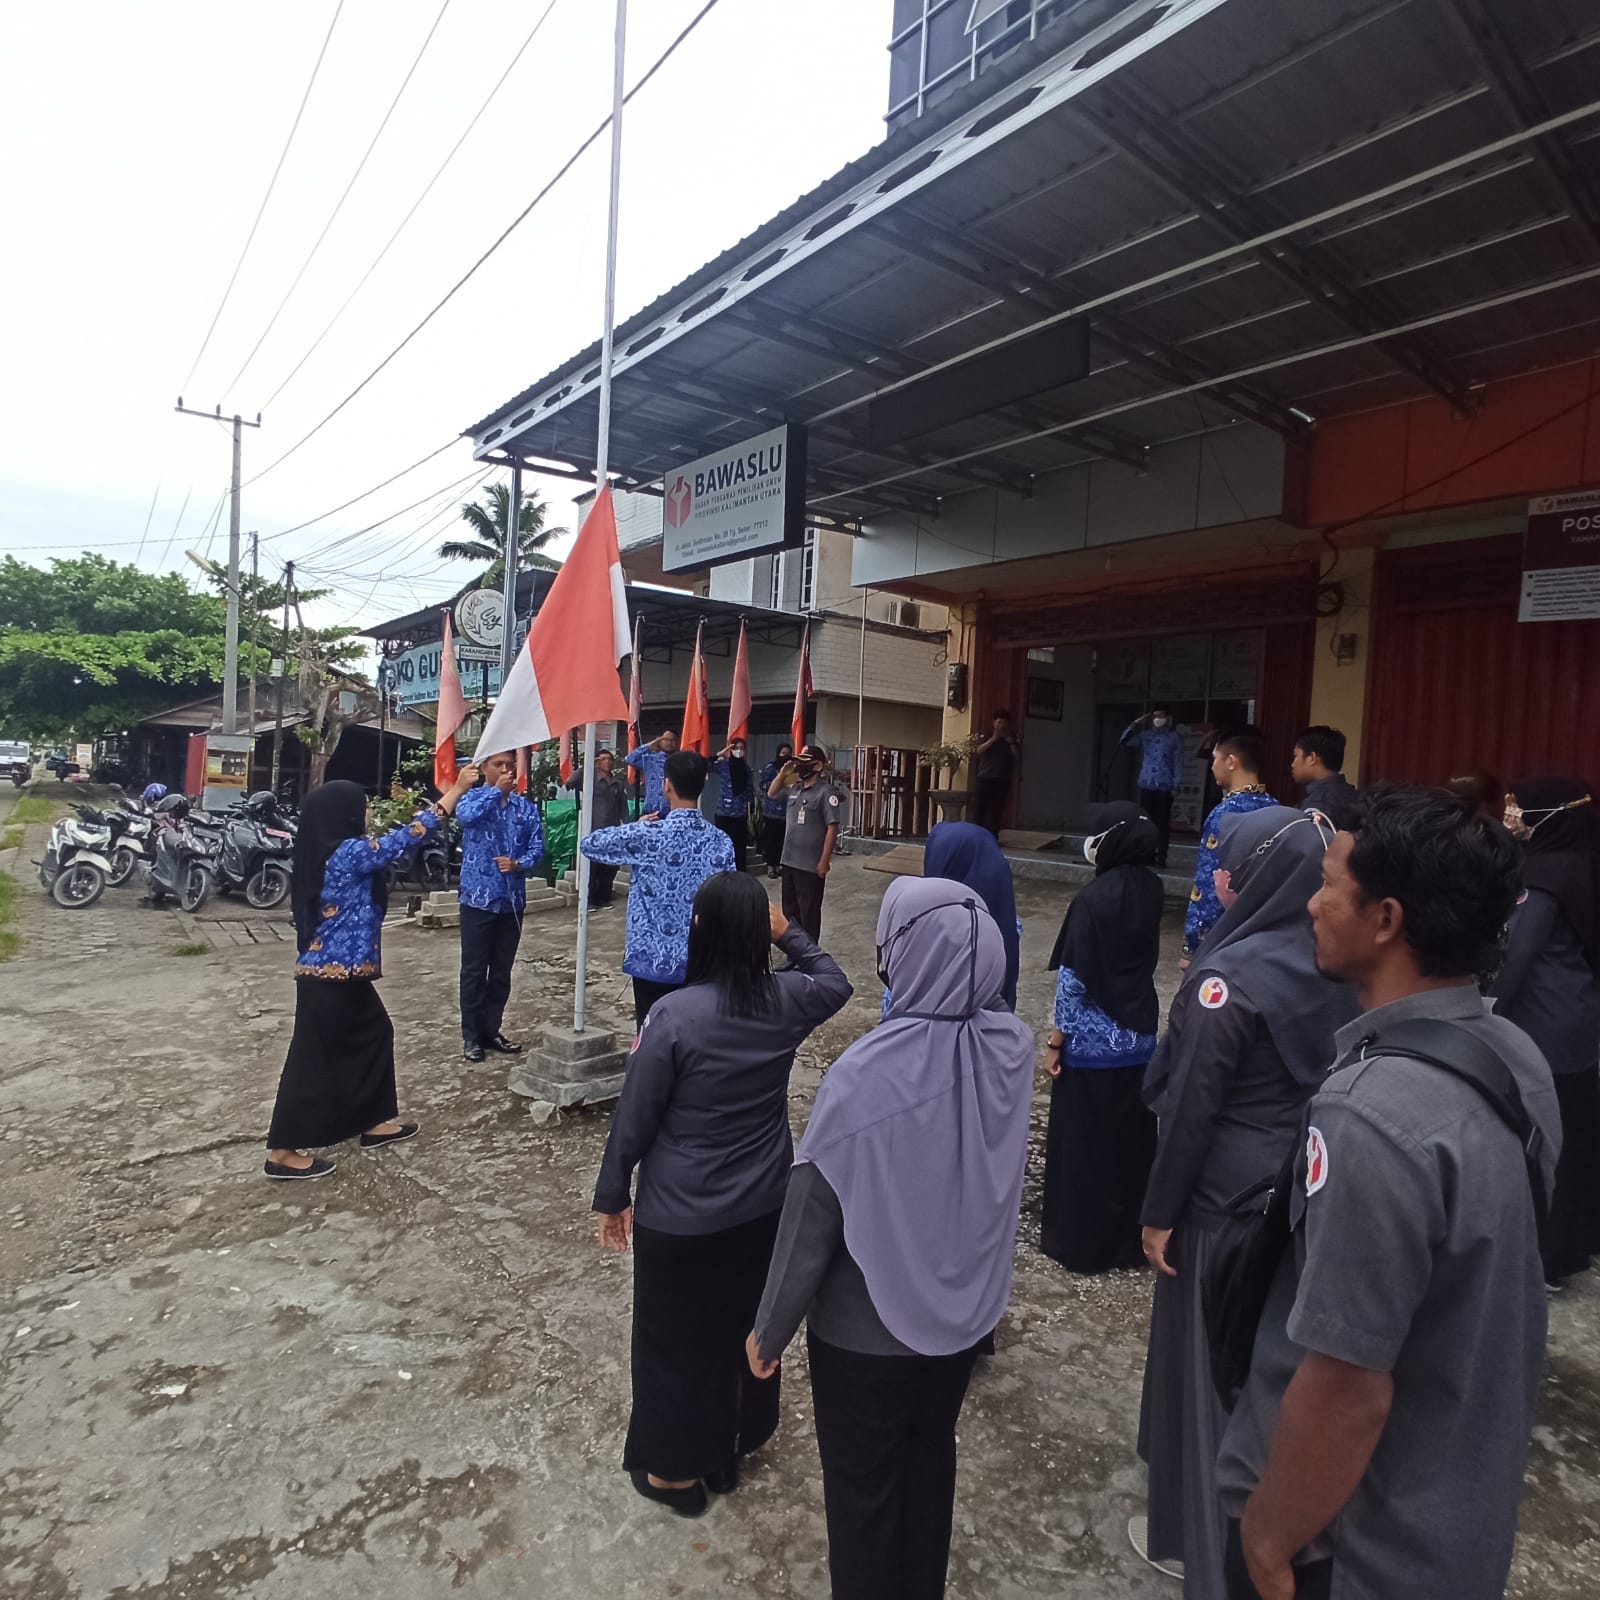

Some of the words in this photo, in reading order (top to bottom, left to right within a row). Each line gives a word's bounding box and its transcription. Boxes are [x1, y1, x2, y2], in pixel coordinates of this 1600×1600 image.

[694, 443, 783, 498] BAWASLU
[737, 482, 764, 496] PEMILIHAN
[766, 476, 782, 487] UMUM
[695, 505, 721, 519] PROVINSI
[721, 493, 759, 512] KALIMANTAN
[760, 487, 781, 500] UTARA
[753, 519, 769, 529] 77212
